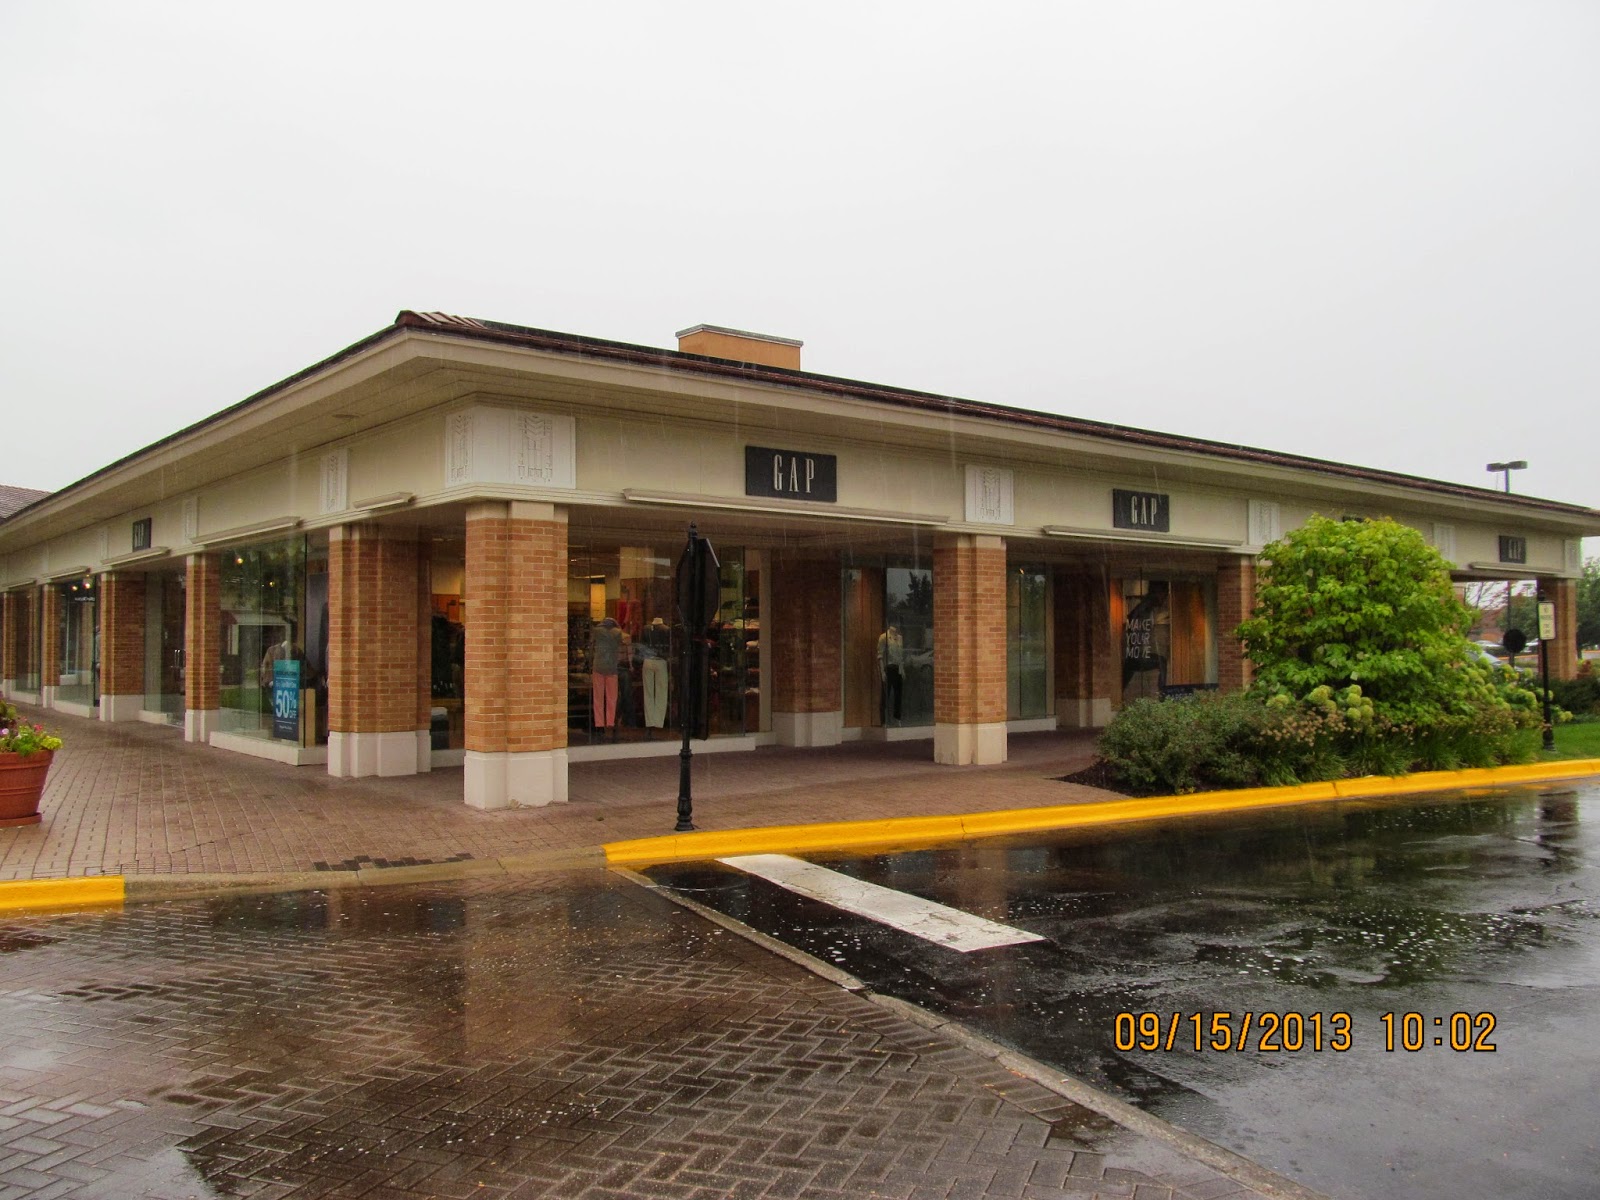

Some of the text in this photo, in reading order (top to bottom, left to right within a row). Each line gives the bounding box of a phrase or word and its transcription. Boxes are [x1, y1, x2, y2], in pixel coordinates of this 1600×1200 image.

[773, 454, 815, 493] GAP
[1131, 495, 1158, 526] GAP
[1125, 618, 1151, 632] MAKE
[1125, 632, 1151, 645] YOUR
